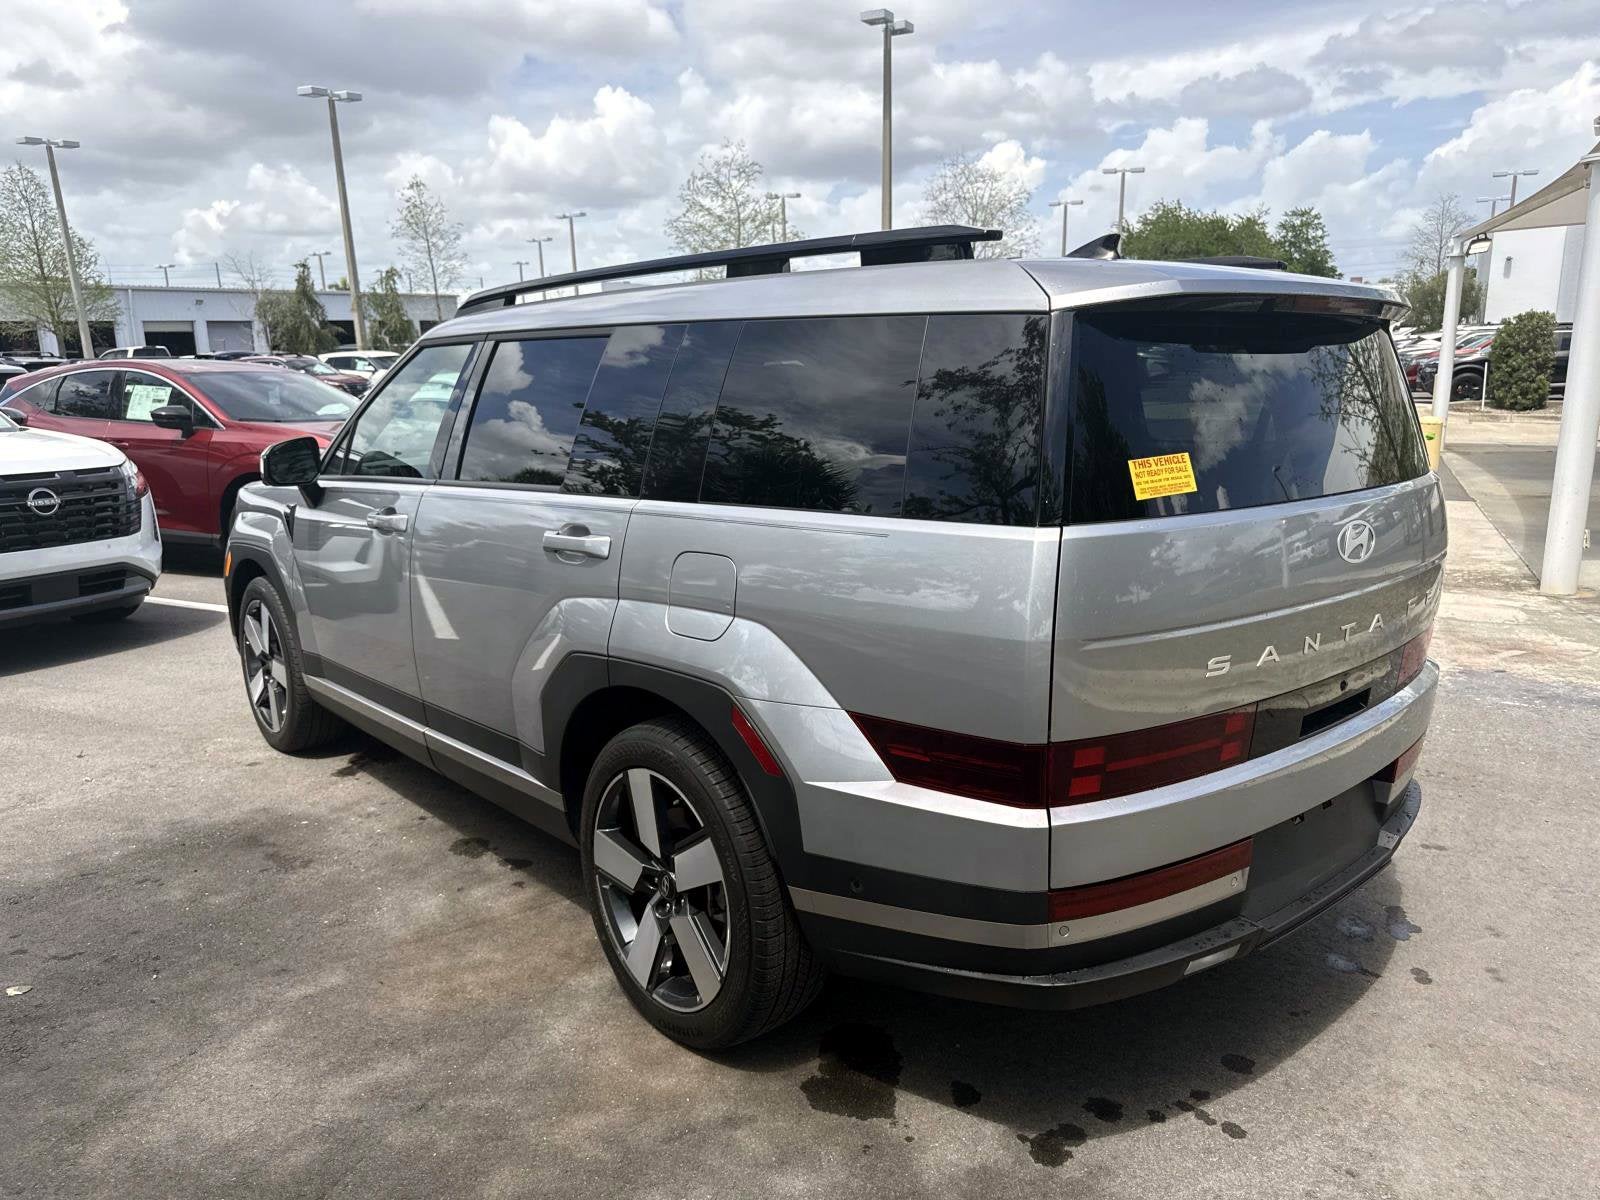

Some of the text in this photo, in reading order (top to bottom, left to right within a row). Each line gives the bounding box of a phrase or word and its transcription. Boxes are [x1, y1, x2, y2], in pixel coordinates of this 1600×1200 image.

[1132, 455, 1187, 470] THIS VEHICLE
[1135, 464, 1189, 479] NOT READY FOR SALE
[27, 498, 61, 507] NISSAN
[1204, 613, 1385, 679] SANTA
